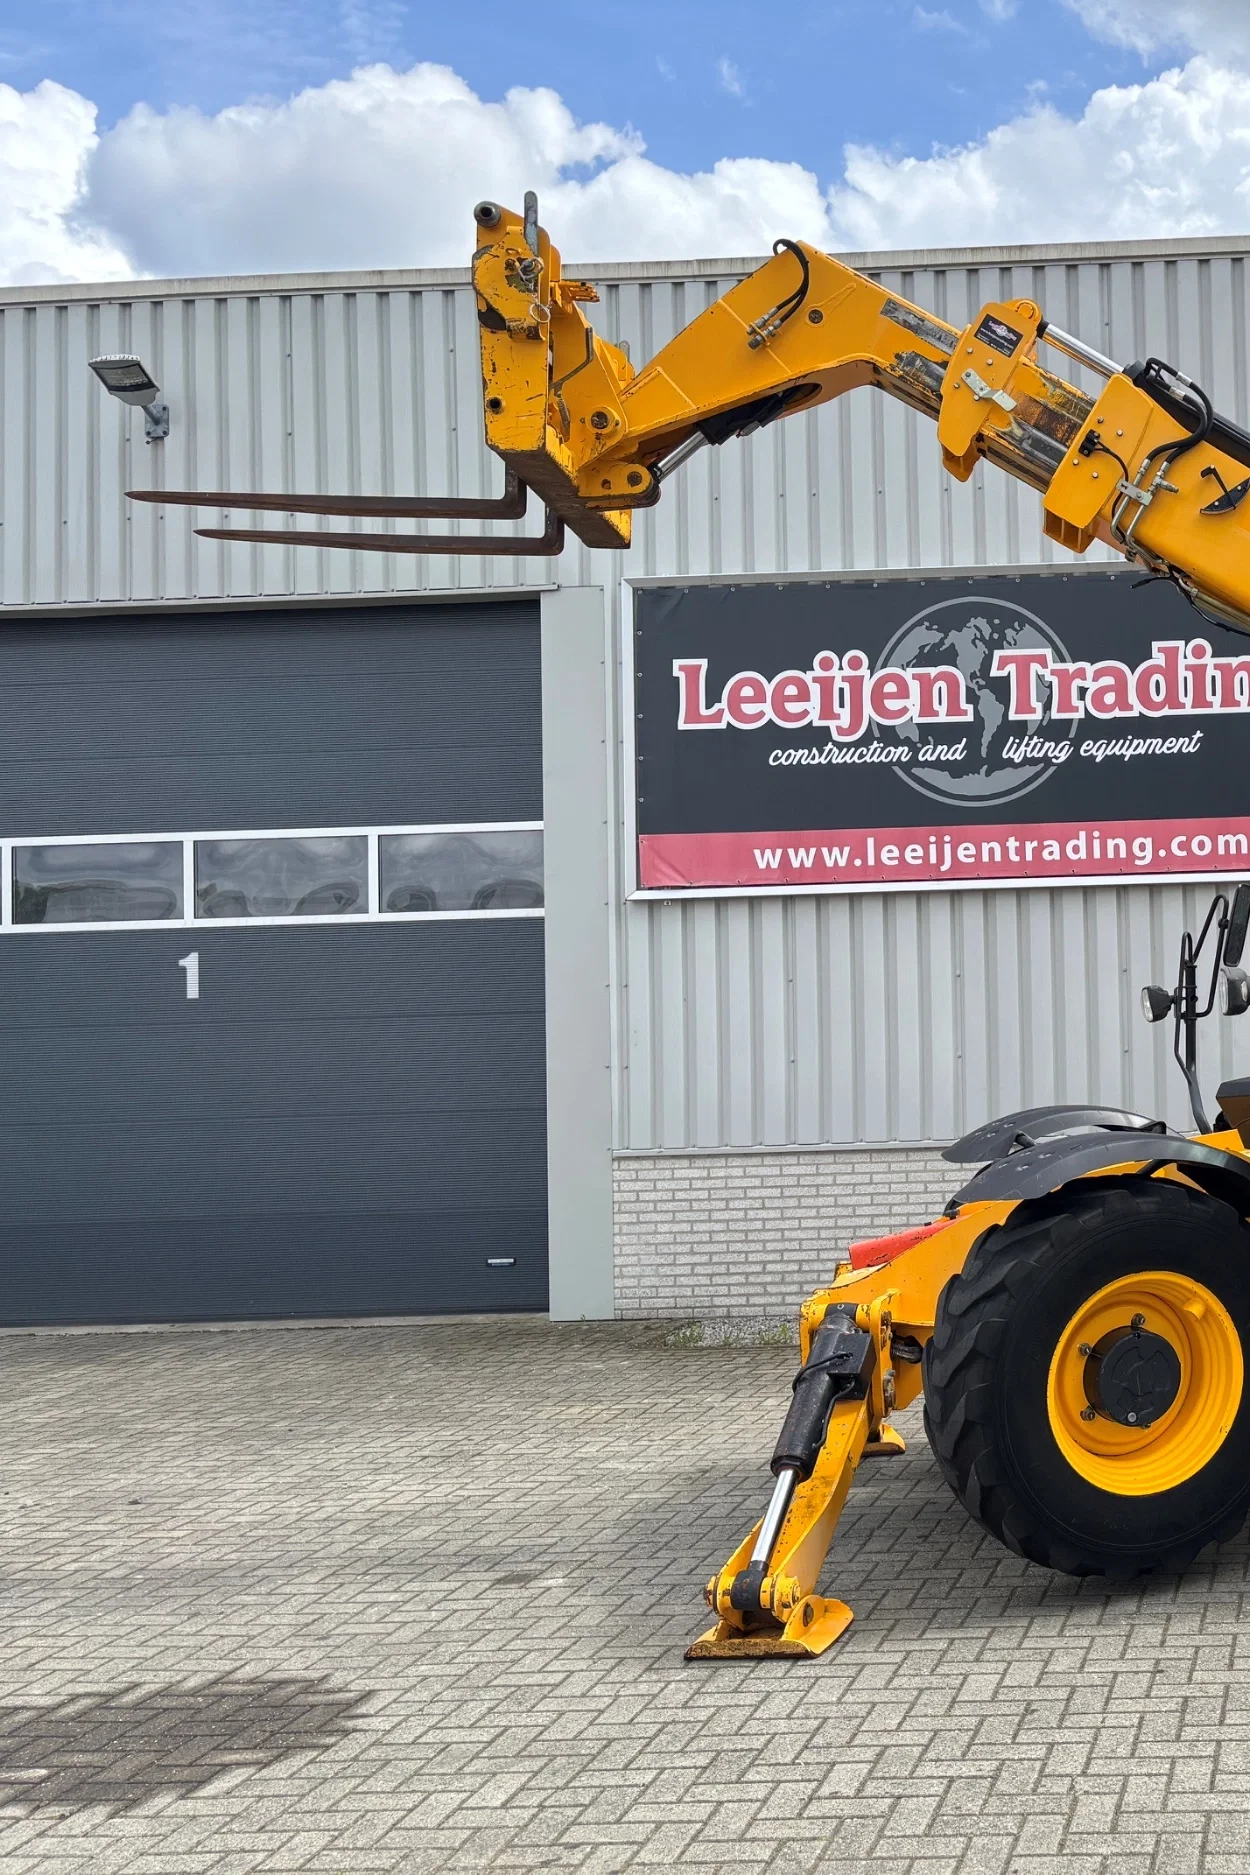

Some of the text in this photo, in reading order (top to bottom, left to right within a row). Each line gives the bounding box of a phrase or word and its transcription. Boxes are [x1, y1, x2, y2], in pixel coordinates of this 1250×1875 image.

[673, 650, 974, 742] Leeijen
[768, 730, 1204, 766] construction and lifting equipment
[753, 830, 1249, 872] www.leeijentrading.com
[178, 951, 200, 999] 1
